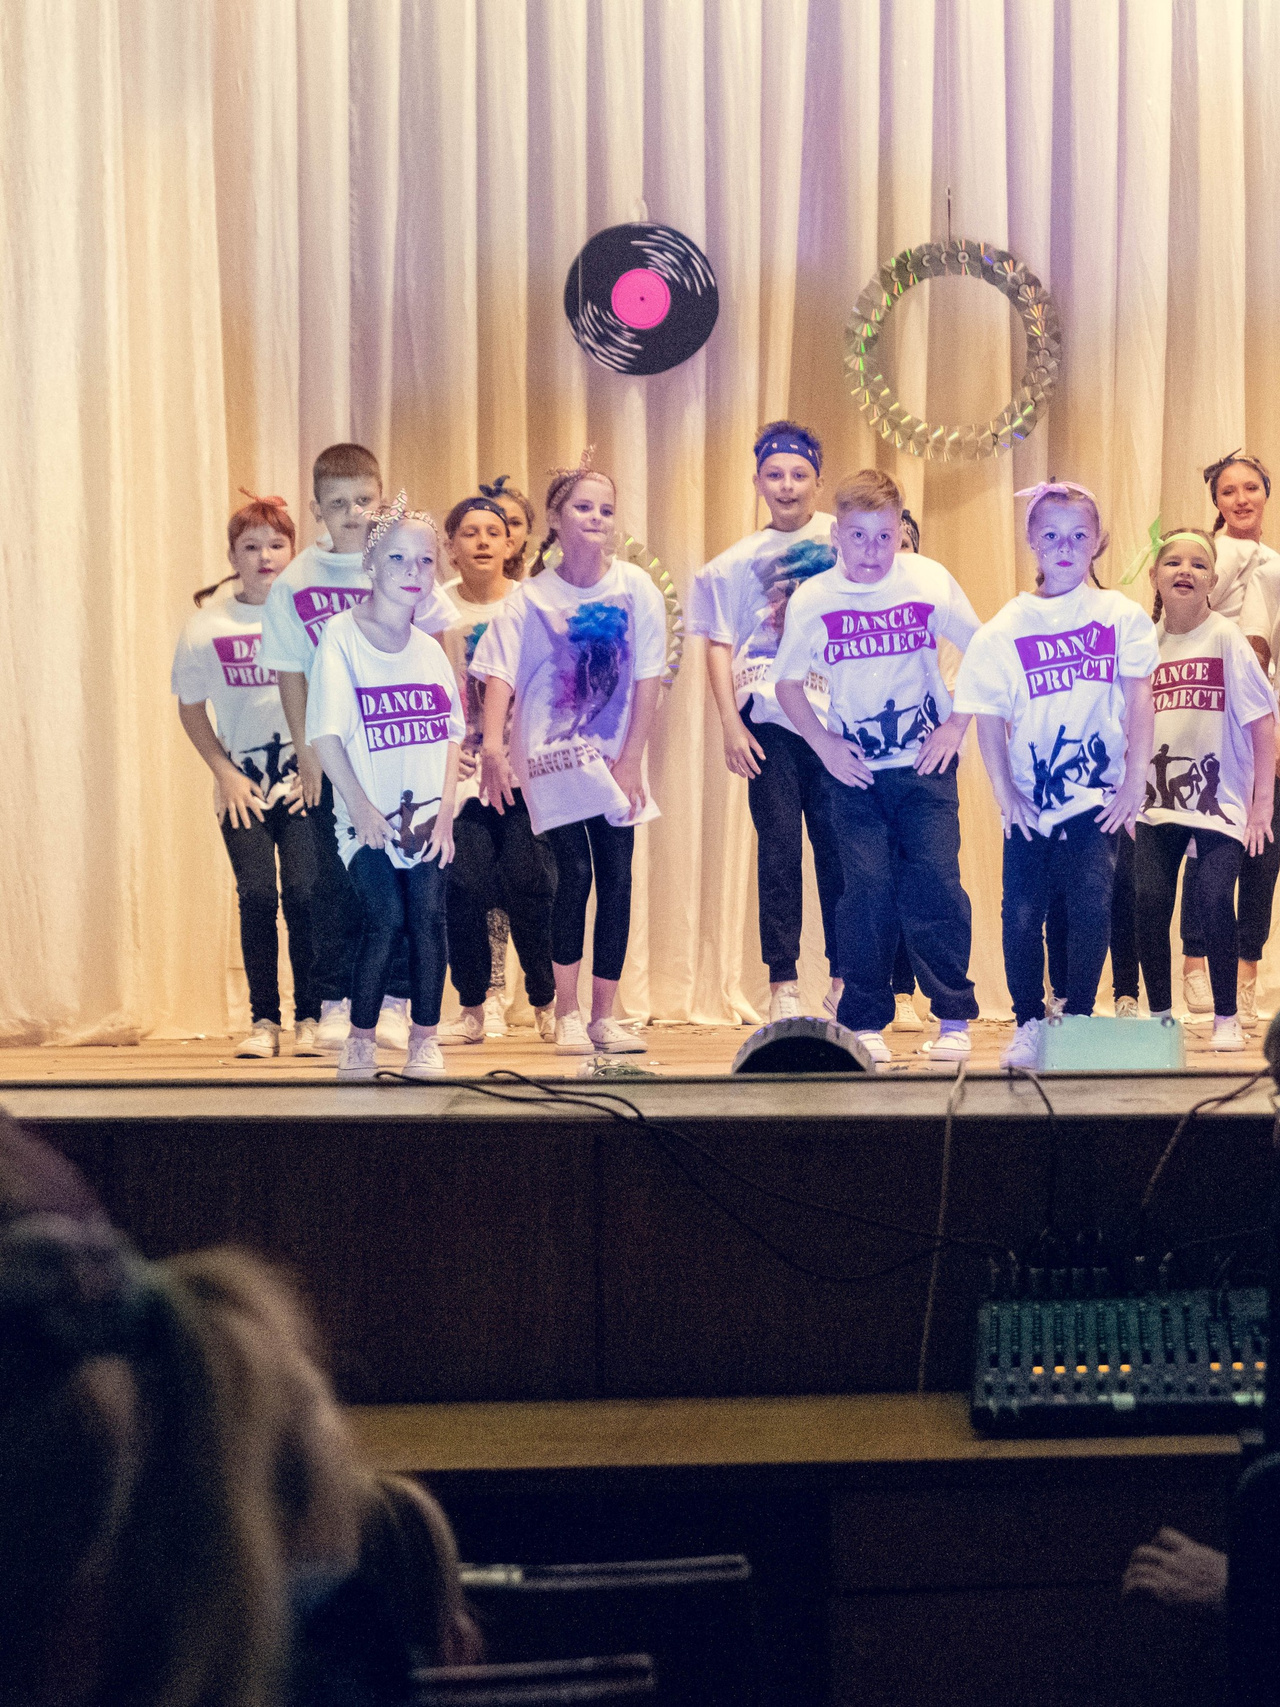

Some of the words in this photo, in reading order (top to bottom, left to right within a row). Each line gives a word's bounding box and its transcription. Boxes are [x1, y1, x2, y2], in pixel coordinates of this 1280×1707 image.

[841, 606, 917, 635] DANCE
[828, 630, 931, 663] PROJECT
[1029, 656, 1111, 695] PROCT
[361, 690, 436, 716] DANCE
[1152, 688, 1222, 710] OJECT
[366, 718, 450, 749] ROJECT
